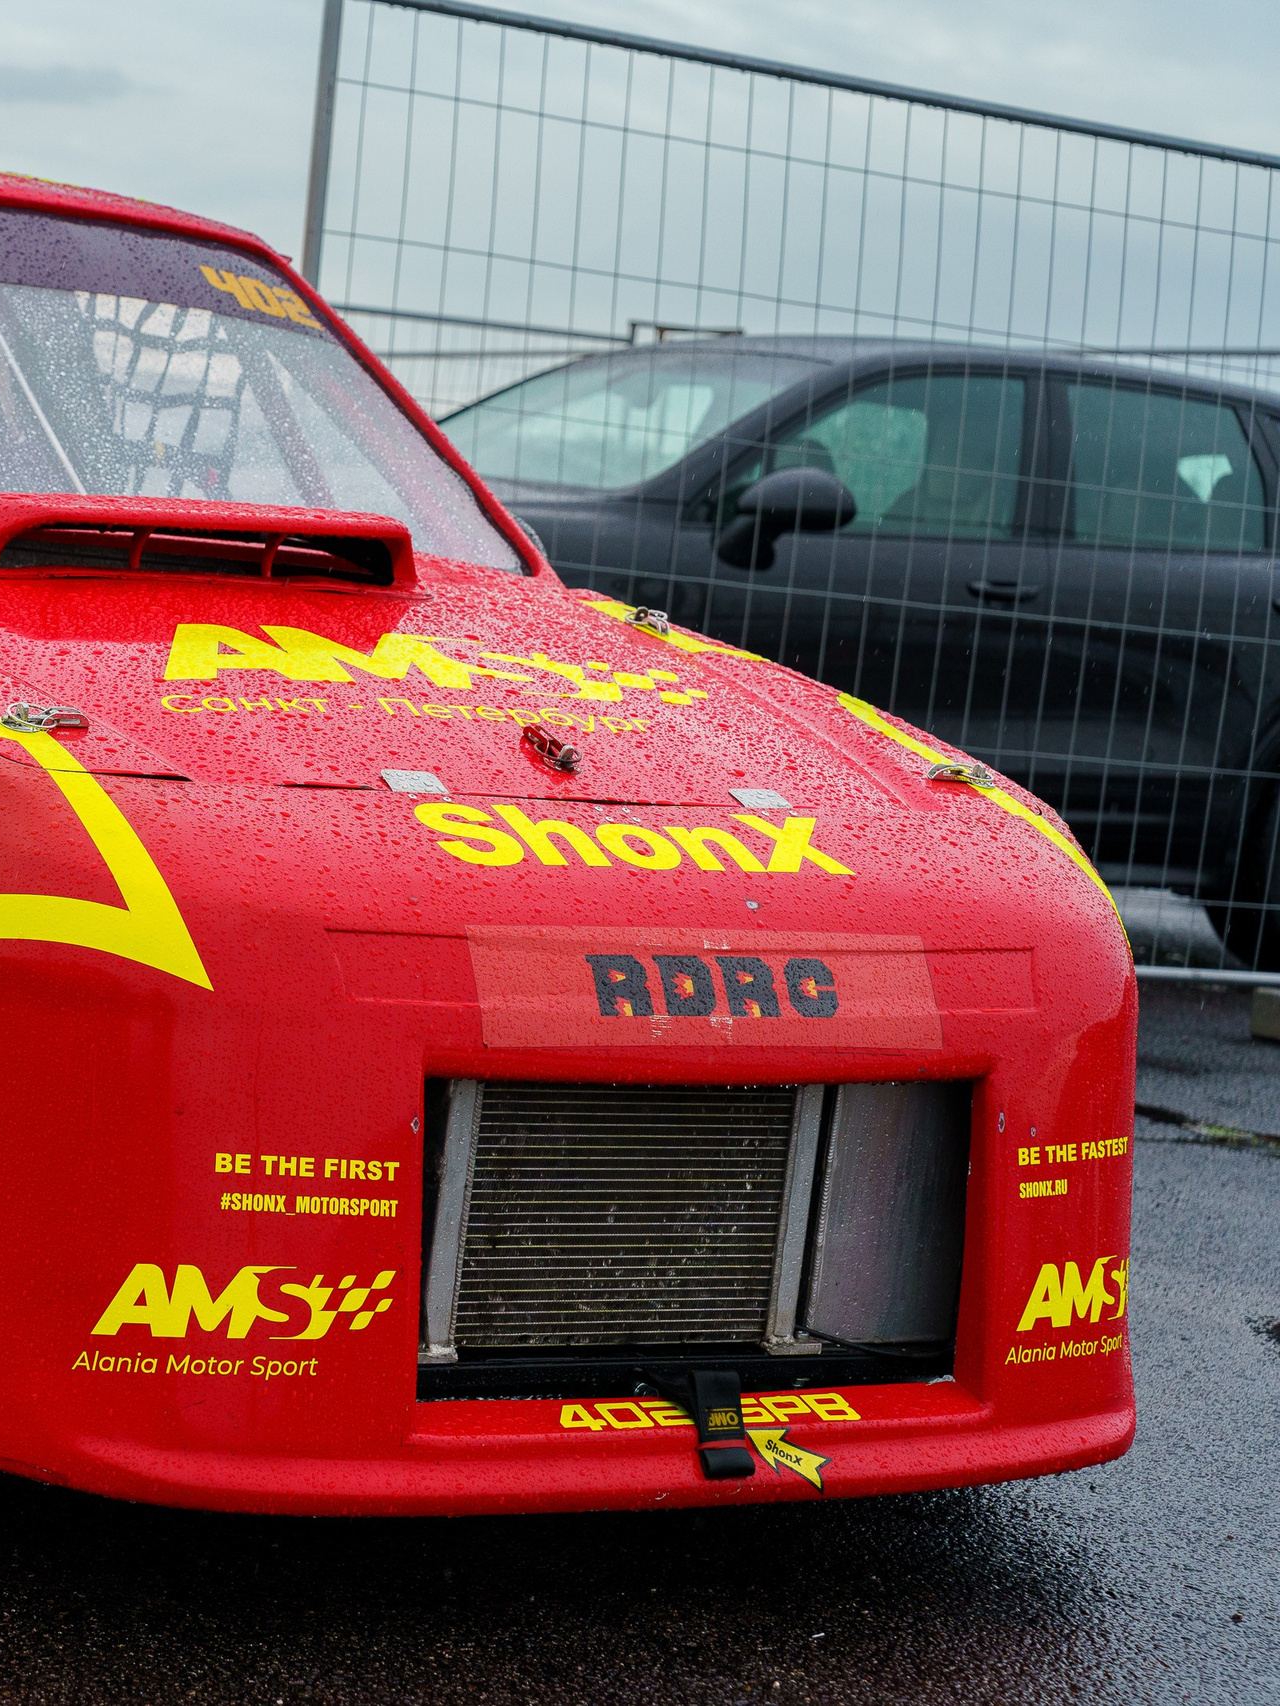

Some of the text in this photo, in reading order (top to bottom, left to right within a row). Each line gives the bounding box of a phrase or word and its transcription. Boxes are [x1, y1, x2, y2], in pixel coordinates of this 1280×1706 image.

[198, 264, 325, 332] 402
[161, 694, 329, 713] Санкт
[377, 697, 654, 736] Петербург
[413, 802, 857, 876] ShonX
[585, 954, 840, 1018] RDRC
[214, 1152, 400, 1182] BE THE FIRST
[1017, 1136, 1129, 1166] BE THE FASTEST
[1019, 1178, 1068, 1199] SHONX.RU
[220, 1192, 399, 1218] #SHONX_MOTORSPORT
[71, 1350, 319, 1381] Alania Motor Sport
[1004, 1333, 1123, 1366] Alania Motor Sport
[559, 1392, 862, 1431] 402 SPB
[765, 1438, 804, 1467] ShonX
